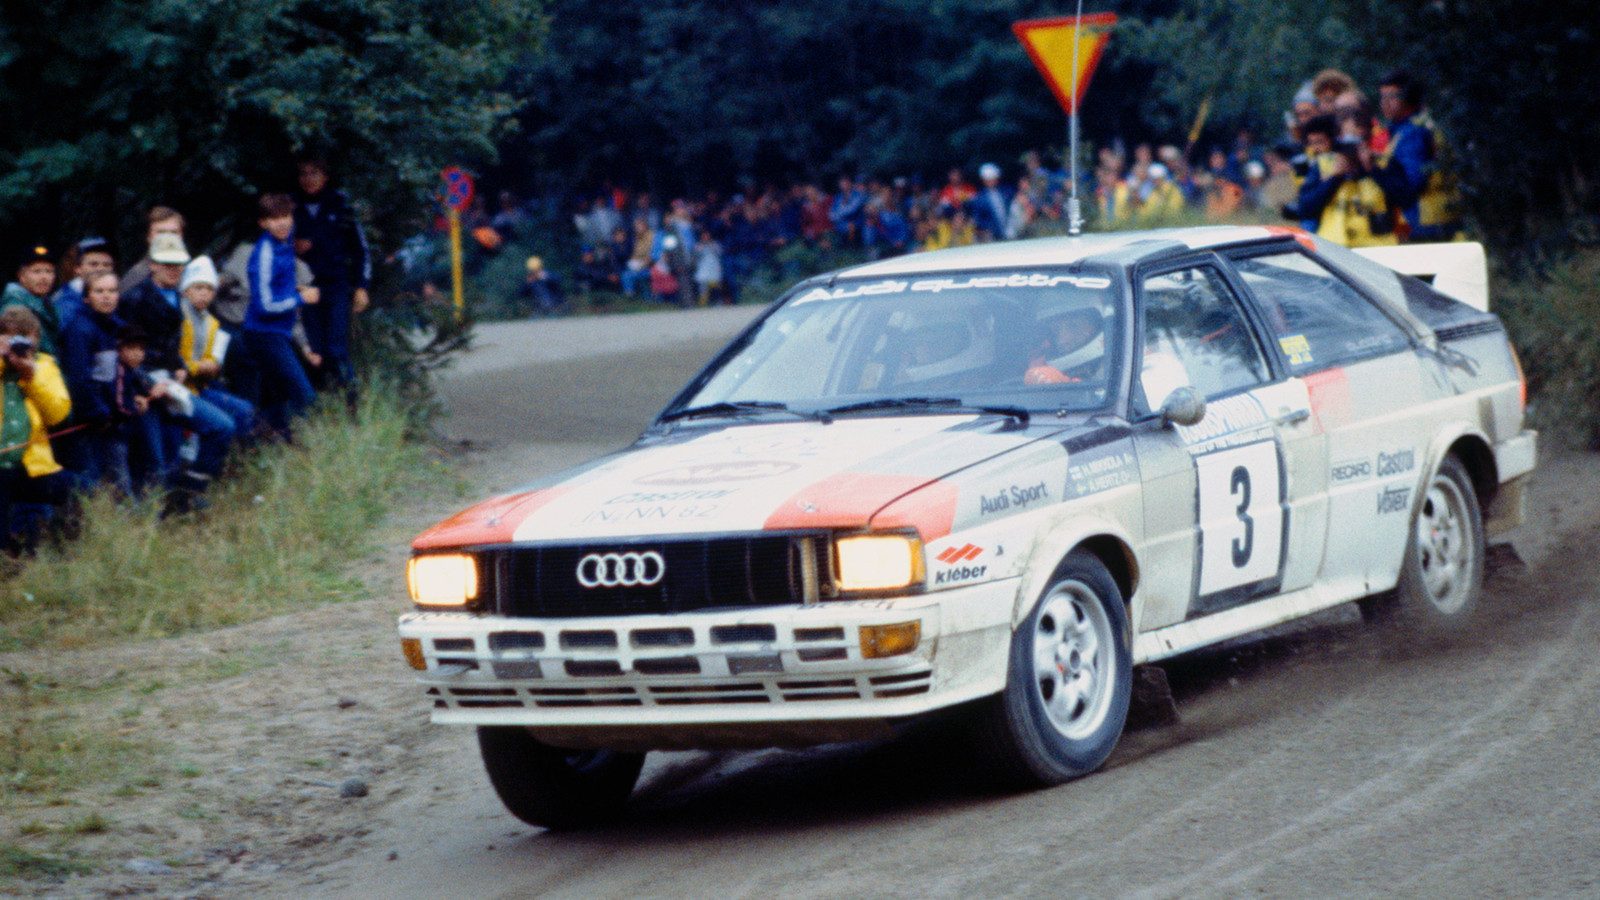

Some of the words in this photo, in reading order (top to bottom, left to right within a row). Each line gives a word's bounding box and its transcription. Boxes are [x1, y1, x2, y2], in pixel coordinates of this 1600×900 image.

[790, 280, 907, 306] Audi
[910, 273, 1110, 292] quattro
[1331, 461, 1370, 480] RECARO
[980, 488, 1010, 516] Audi
[1010, 481, 1048, 508] Sport
[1230, 465, 1254, 569] 3
